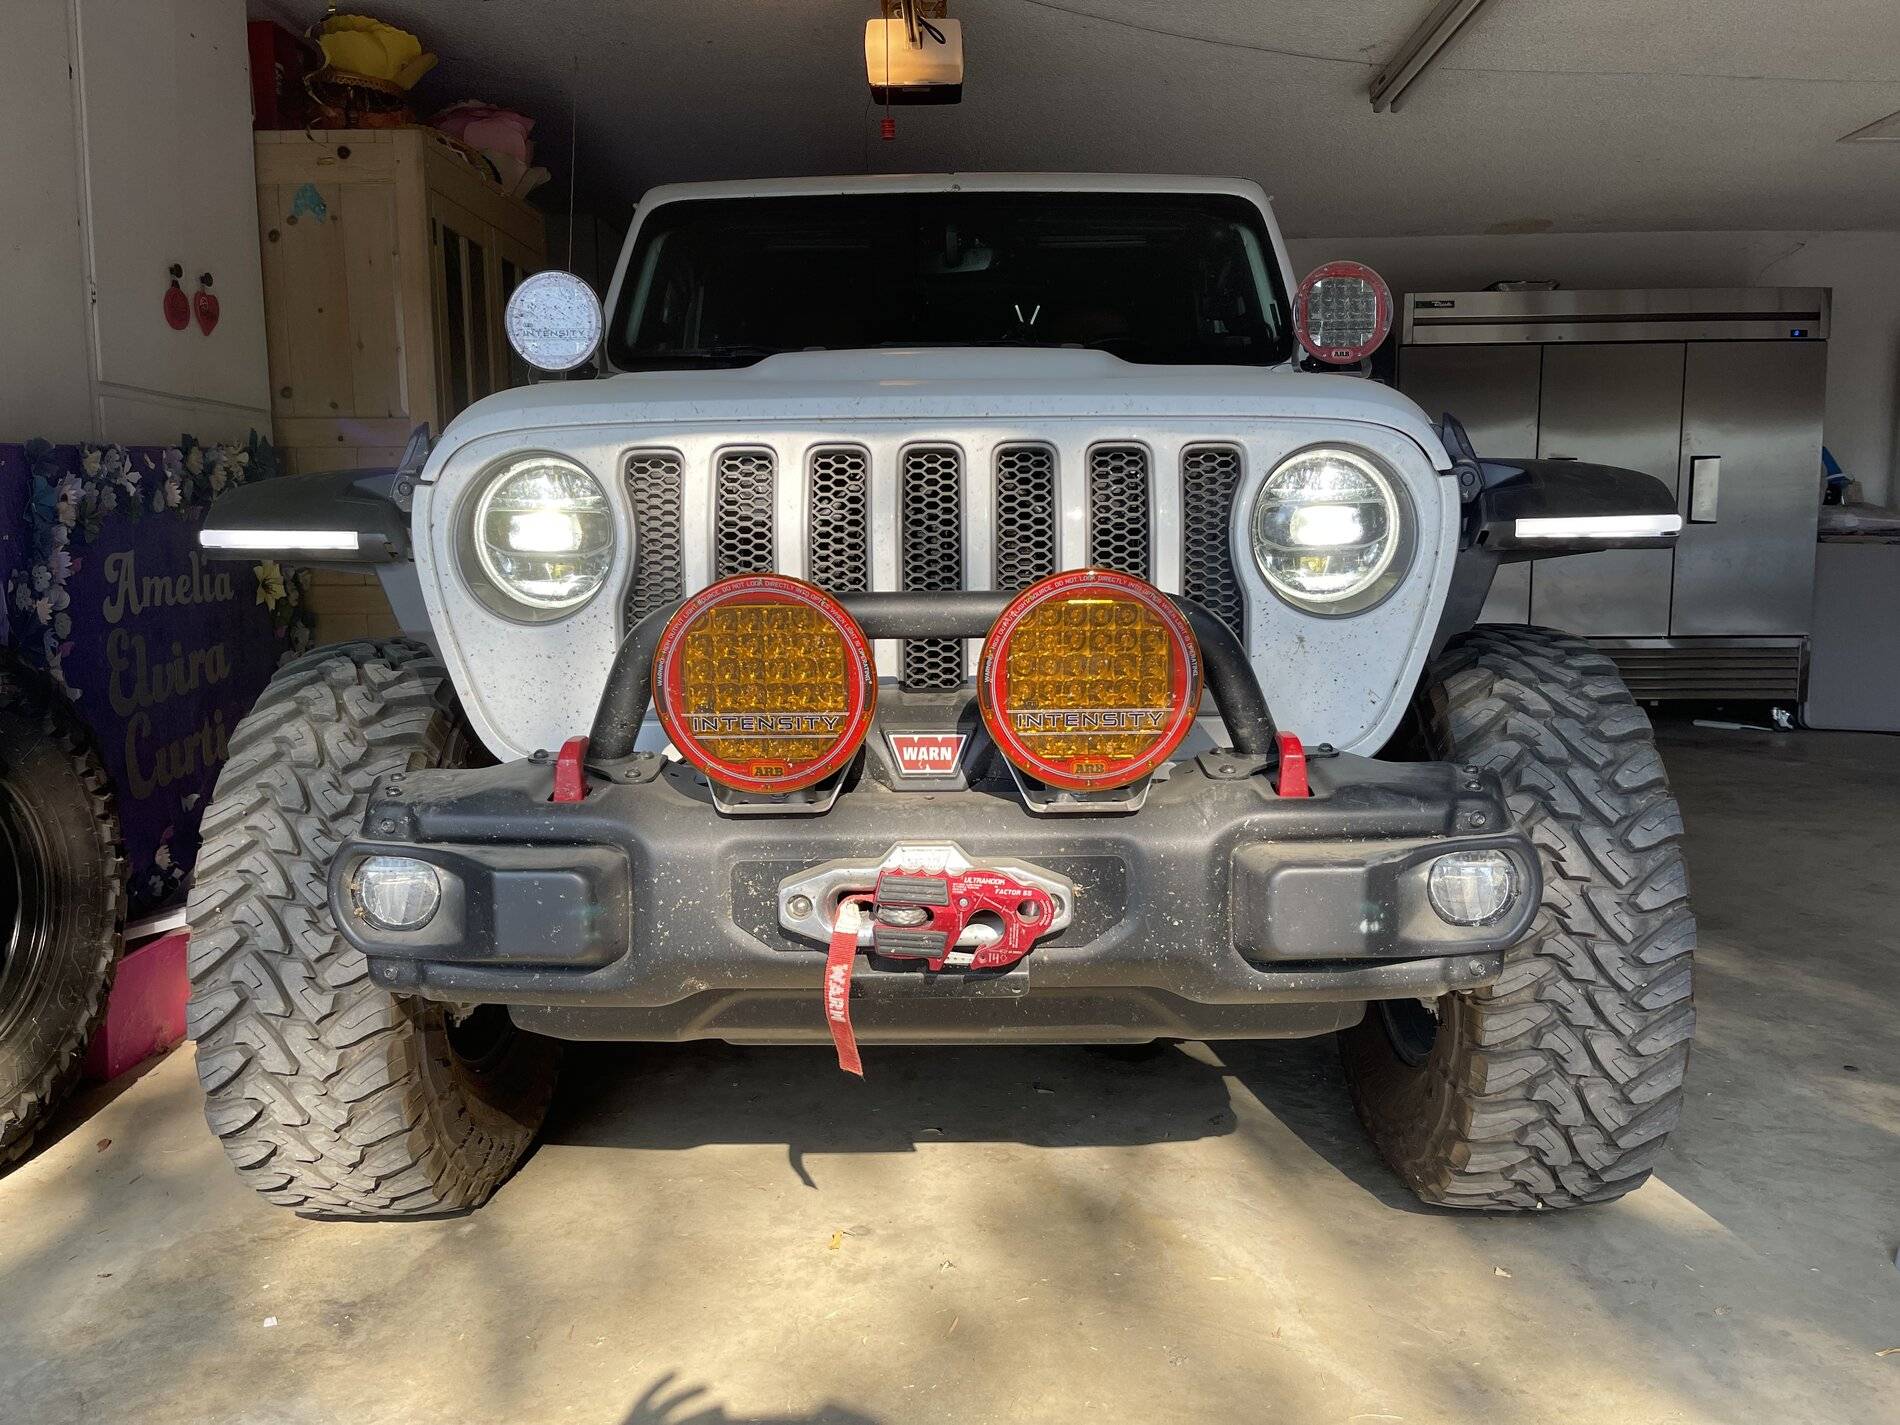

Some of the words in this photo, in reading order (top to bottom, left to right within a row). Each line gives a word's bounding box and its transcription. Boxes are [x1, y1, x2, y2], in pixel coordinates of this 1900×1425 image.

[522, 329, 585, 338] INTENSITY
[103, 549, 235, 623] Amelia
[669, 618, 685, 639] OUTPUT
[683, 604, 698, 619] LIGHT
[731, 582, 745, 590] NOT
[765, 583, 794, 591] DIRECTLY
[844, 623, 856, 640] LIGHT
[106, 627, 231, 717] Elvira
[692, 715, 840, 732] INTENSITY
[1017, 711, 1165, 728] INTENSITY
[903, 746, 952, 761] WARN
[753, 766, 784, 777] ARB
[1074, 763, 1105, 774] ARB
[964, 877, 1006, 886] ULTRAHOOK
[994, 888, 1021, 897] FACTOR
[828, 964, 849, 1023] WARN
